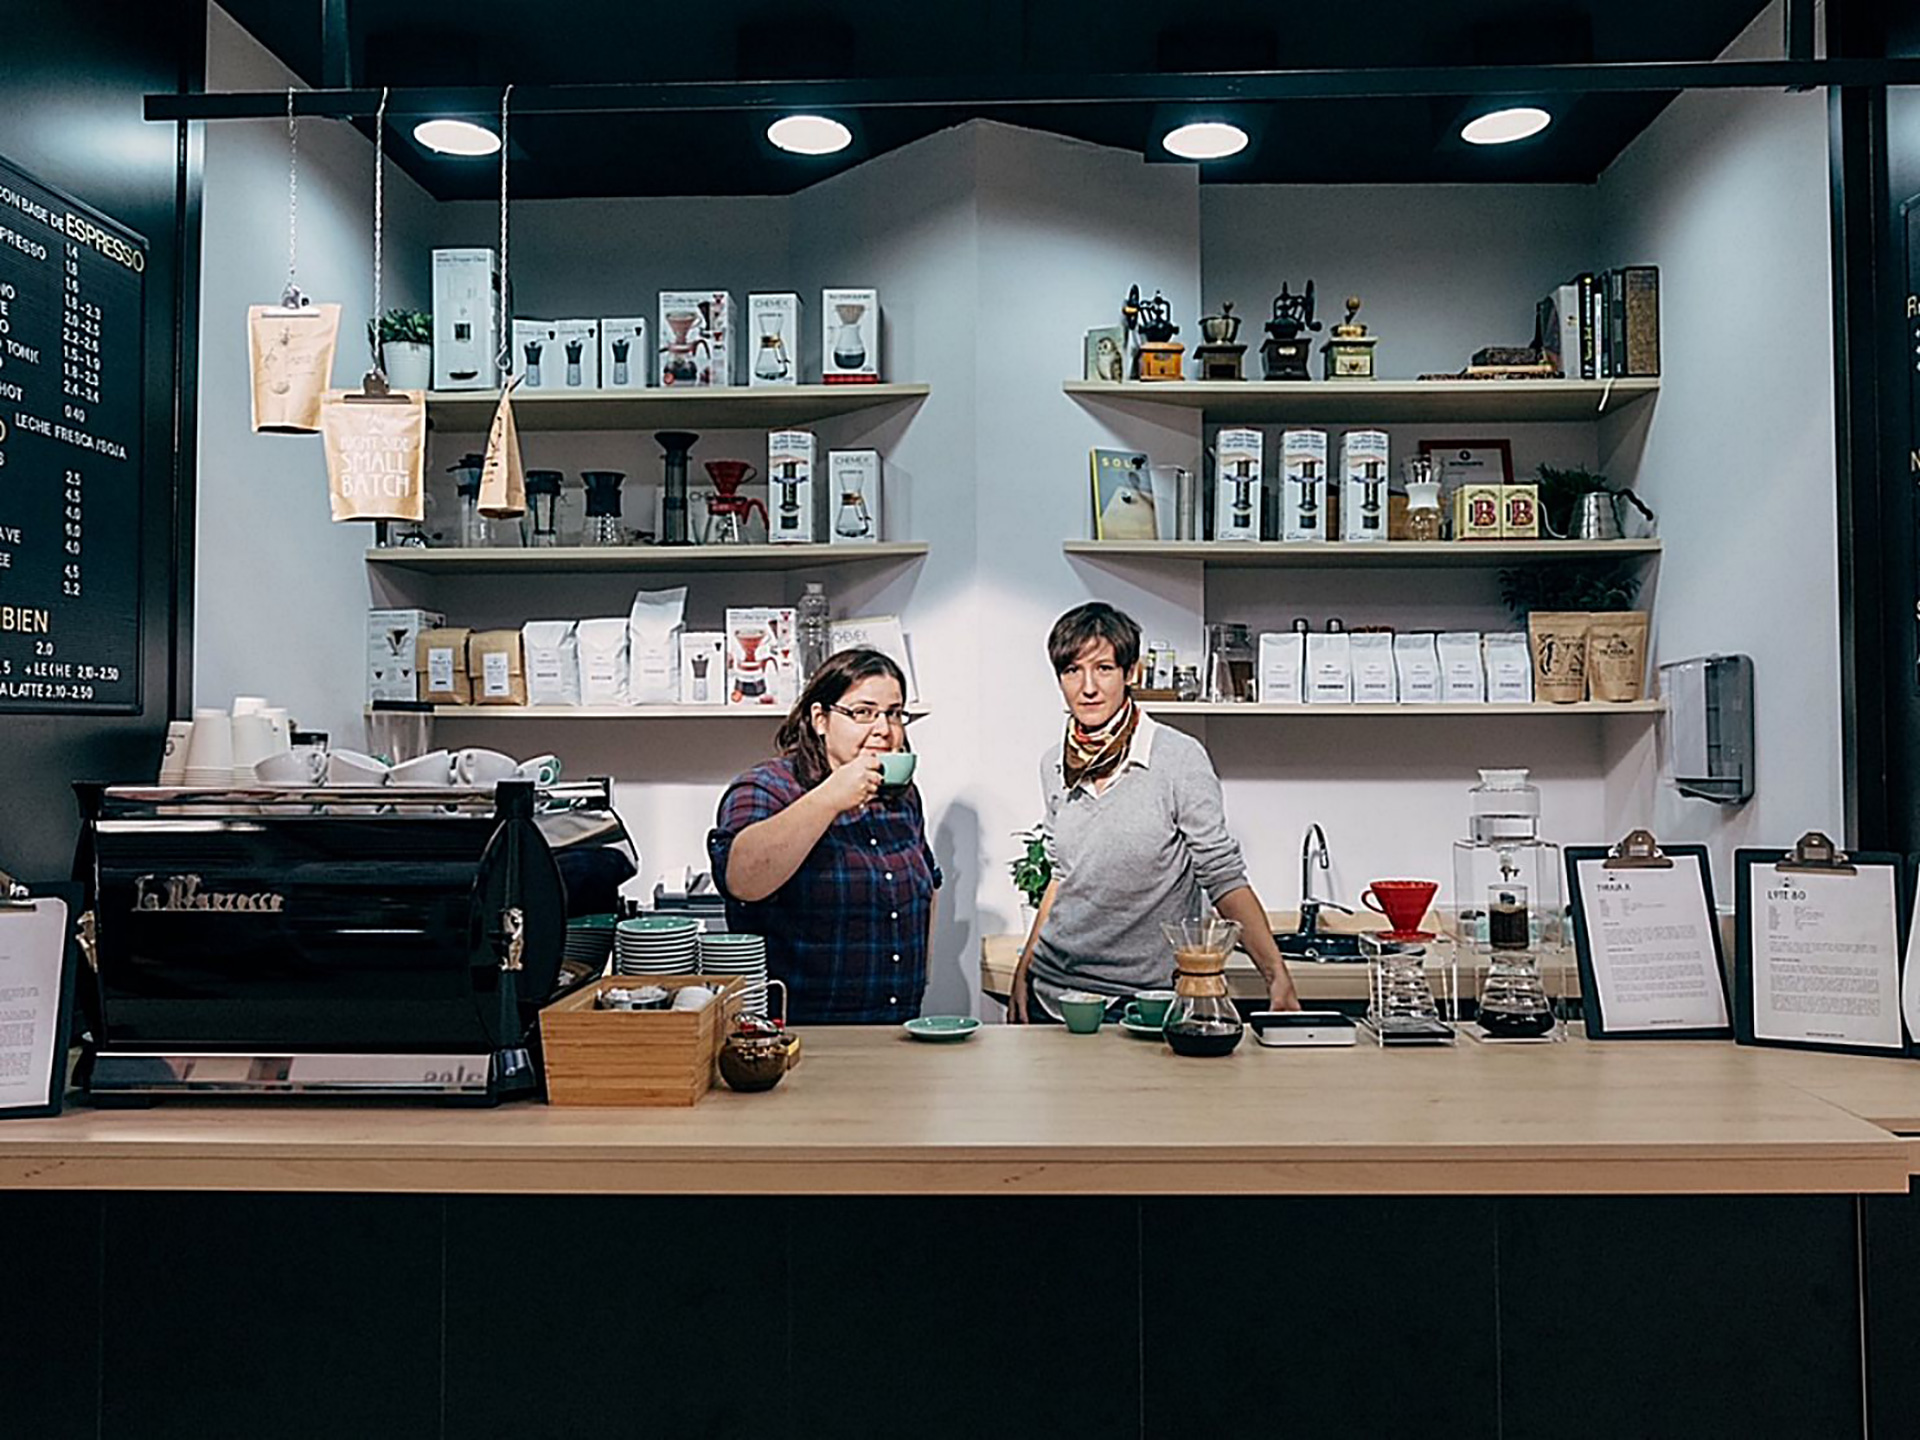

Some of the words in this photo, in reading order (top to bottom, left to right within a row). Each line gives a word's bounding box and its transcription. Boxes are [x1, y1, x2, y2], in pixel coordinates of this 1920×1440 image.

[21, 197, 48, 223] BASE
[50, 213, 64, 232] DE
[65, 212, 145, 273] ESPRESSO
[7, 339, 39, 364] TONIC
[15, 412, 51, 437] LECHE
[340, 451, 409, 474] SMALL
[341, 473, 410, 497] BATCH
[36, 641, 54, 655] 2.0
